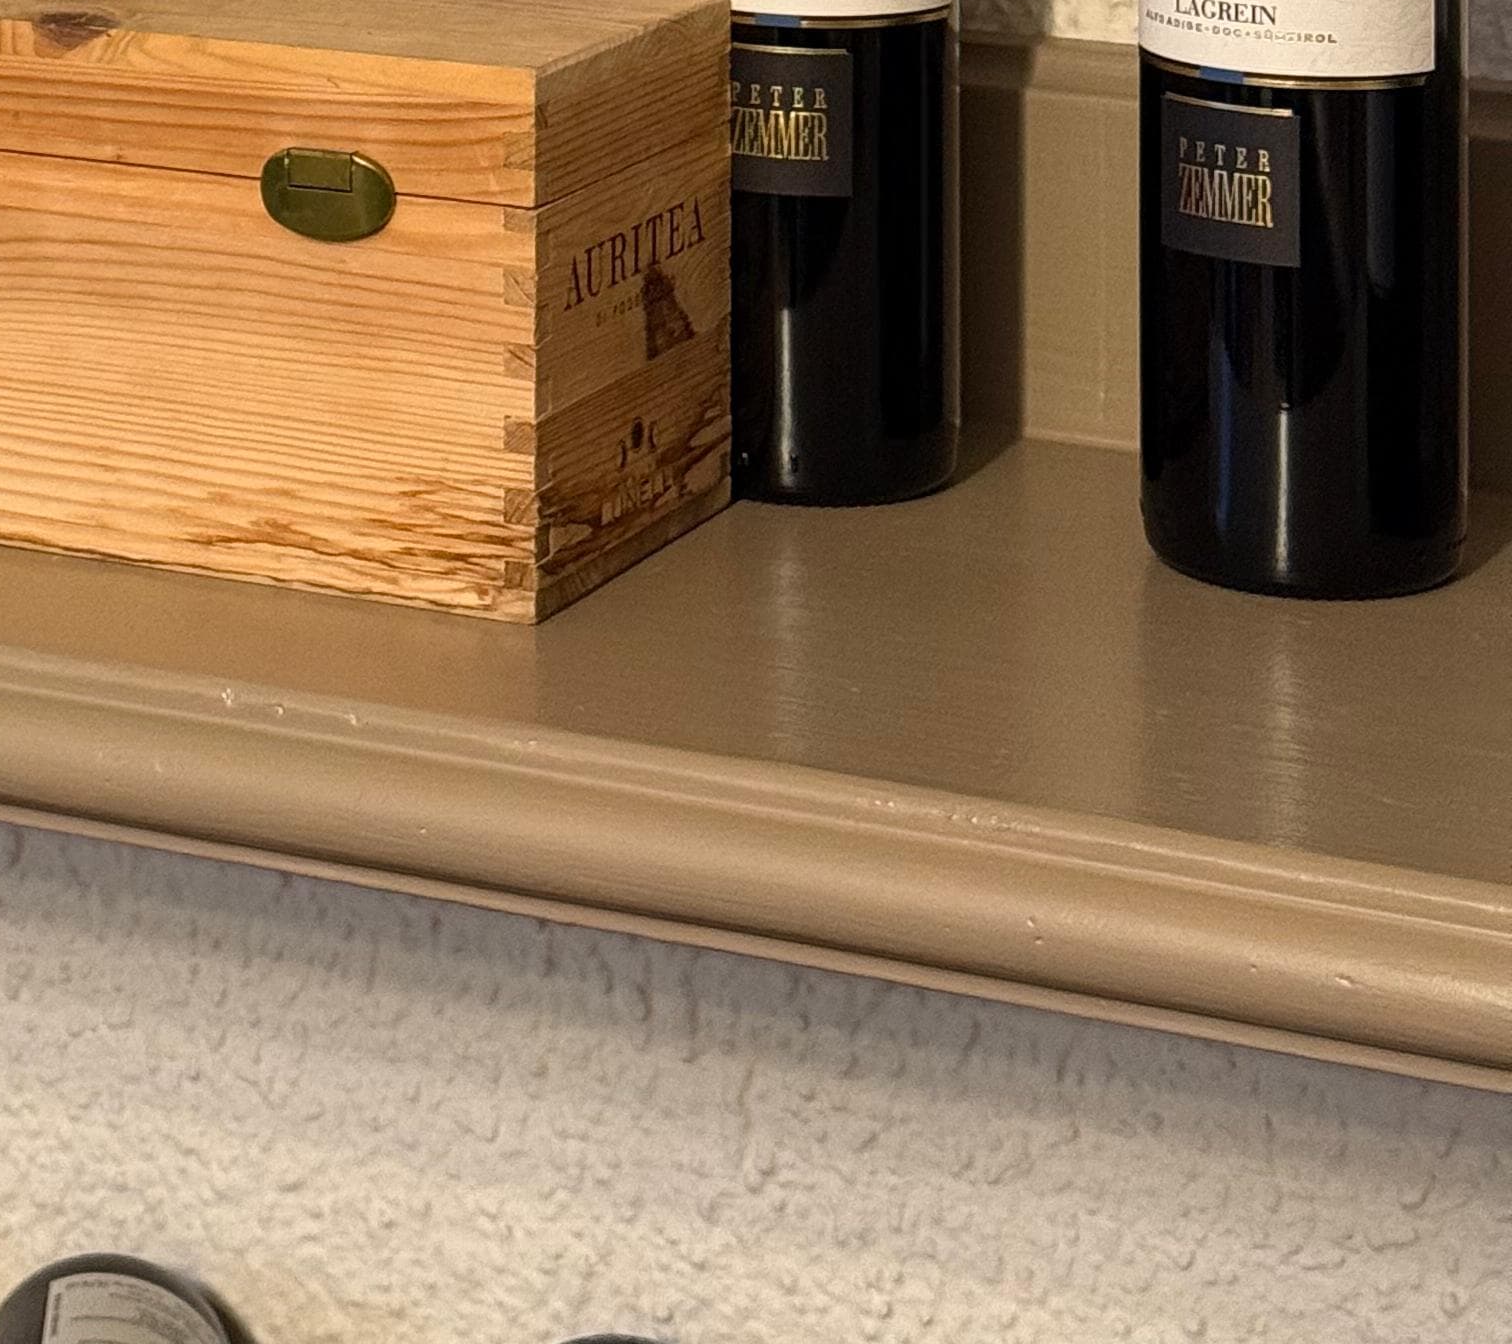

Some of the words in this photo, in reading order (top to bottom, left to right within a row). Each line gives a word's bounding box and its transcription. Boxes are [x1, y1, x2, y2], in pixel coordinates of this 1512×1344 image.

[1213, 25, 1244, 39] DOC
[732, 81, 828, 110] PETER
[732, 108, 829, 161] ZEMMER
[1179, 136, 1271, 173] PETER
[1178, 163, 1274, 229] ZEMMER
[563, 197, 706, 311] AURITEA
